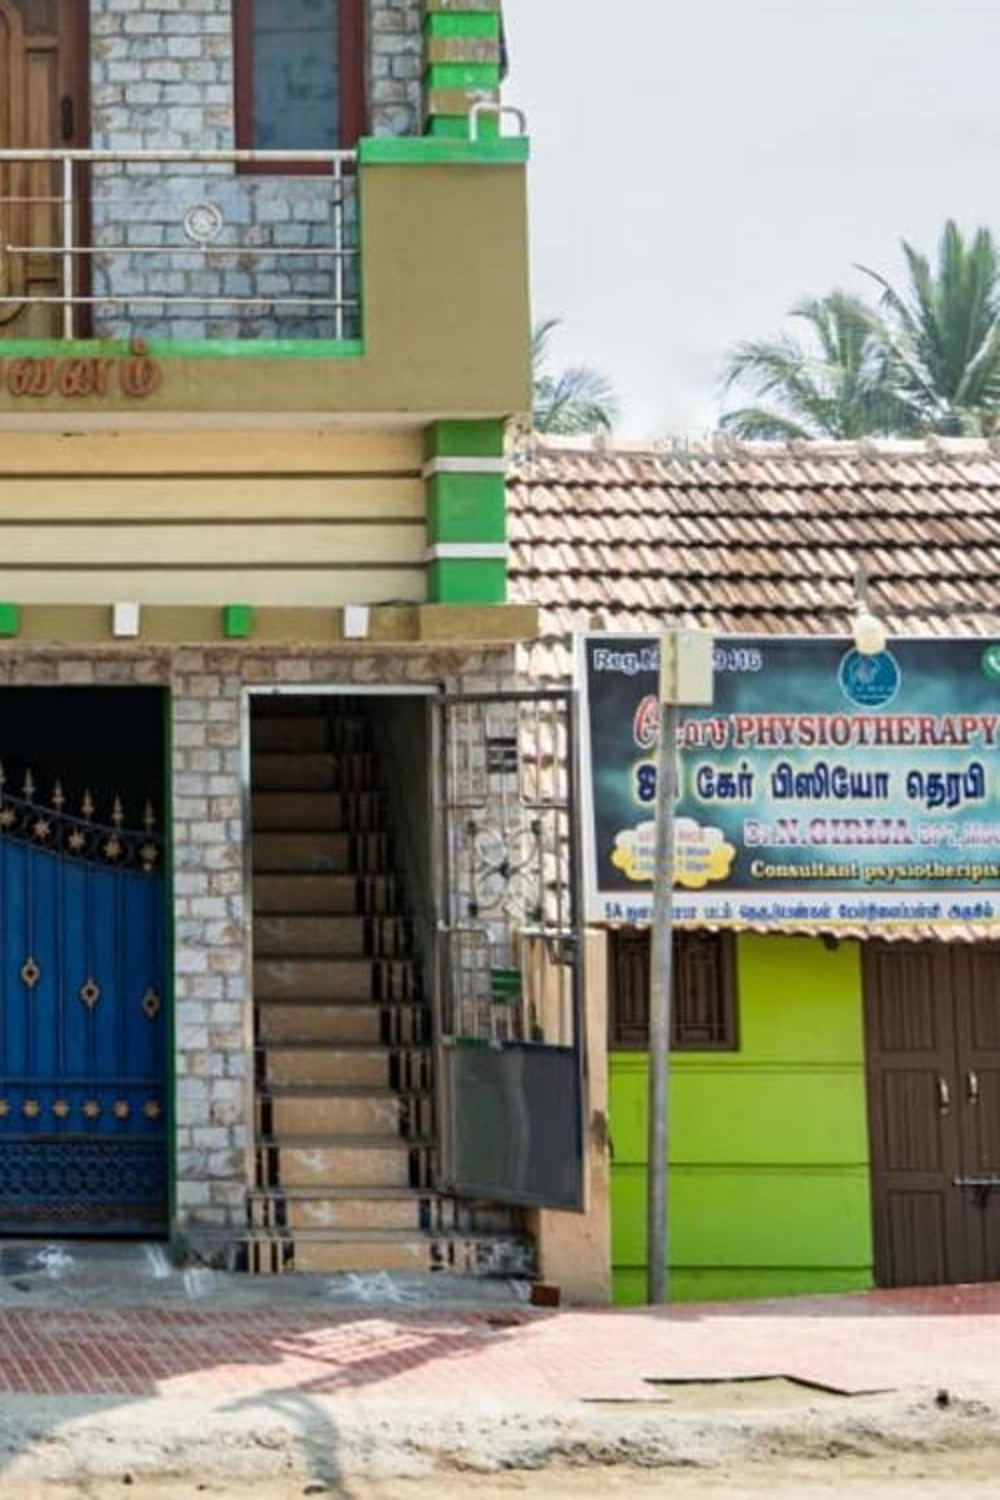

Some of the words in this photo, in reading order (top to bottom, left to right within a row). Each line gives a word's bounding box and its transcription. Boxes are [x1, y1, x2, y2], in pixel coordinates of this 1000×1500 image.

[733, 713, 999, 747] PHYSIOTHERAPY
[697, 761, 754, 800] கேர்
[771, 762, 889, 800] பிஸியோ
[906, 762, 985, 808] தெரபி
[750, 859, 858, 879] Consultant
